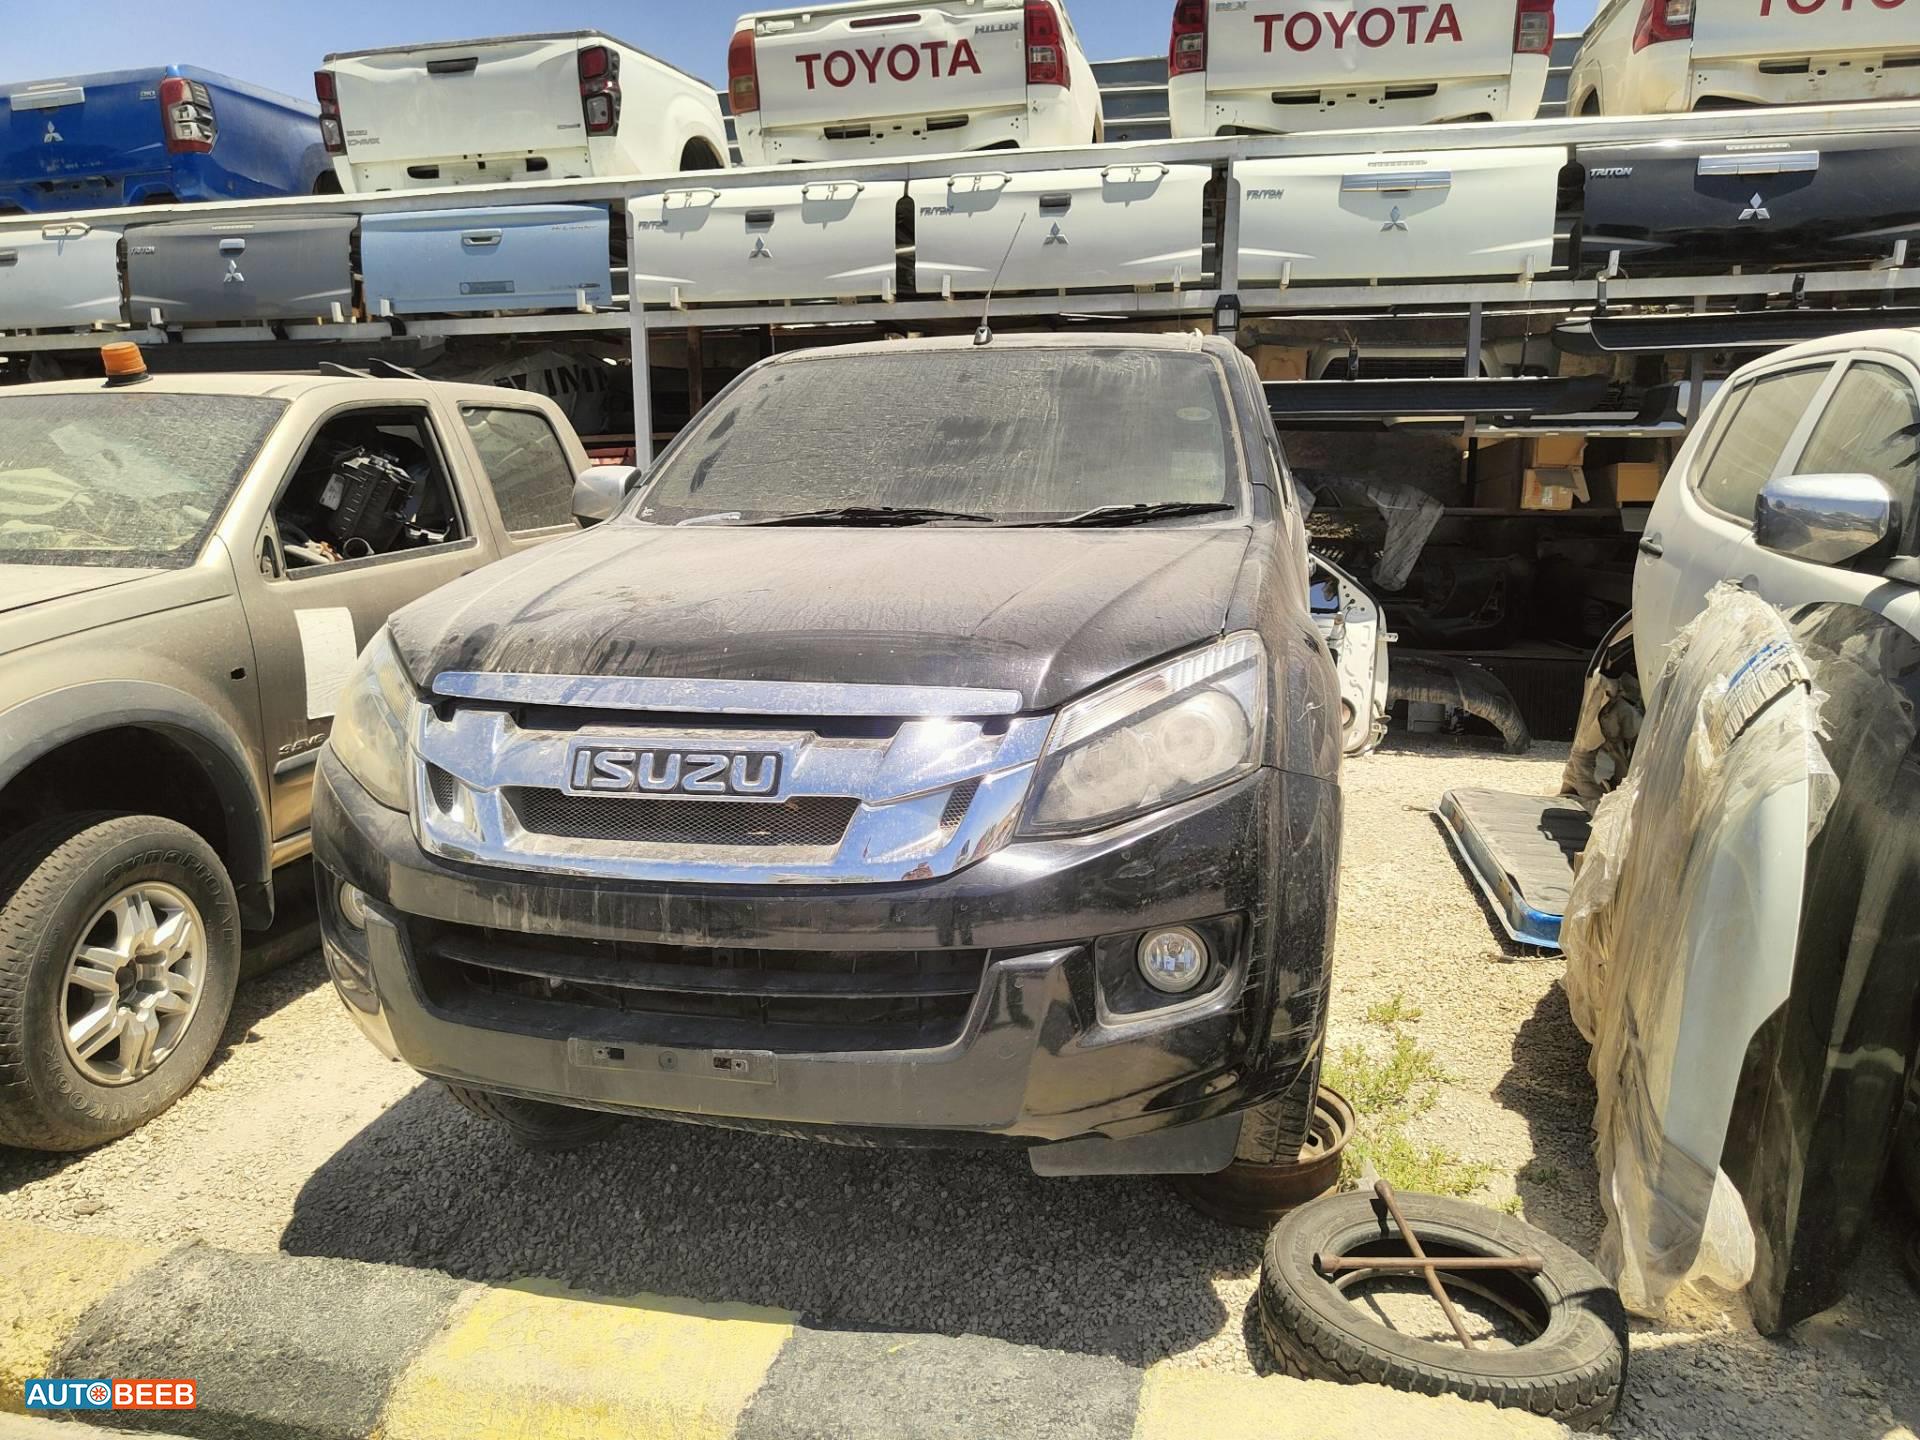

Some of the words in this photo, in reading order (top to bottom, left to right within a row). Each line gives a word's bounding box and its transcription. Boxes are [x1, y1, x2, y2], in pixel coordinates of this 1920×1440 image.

[975, 22, 1019, 34] HILUX
[1254, 3, 1463, 53] TOYOTA
[795, 39, 982, 90] TOYOTA
[1590, 167, 1633, 178] TRITON
[572, 749, 777, 793] ISUZU
